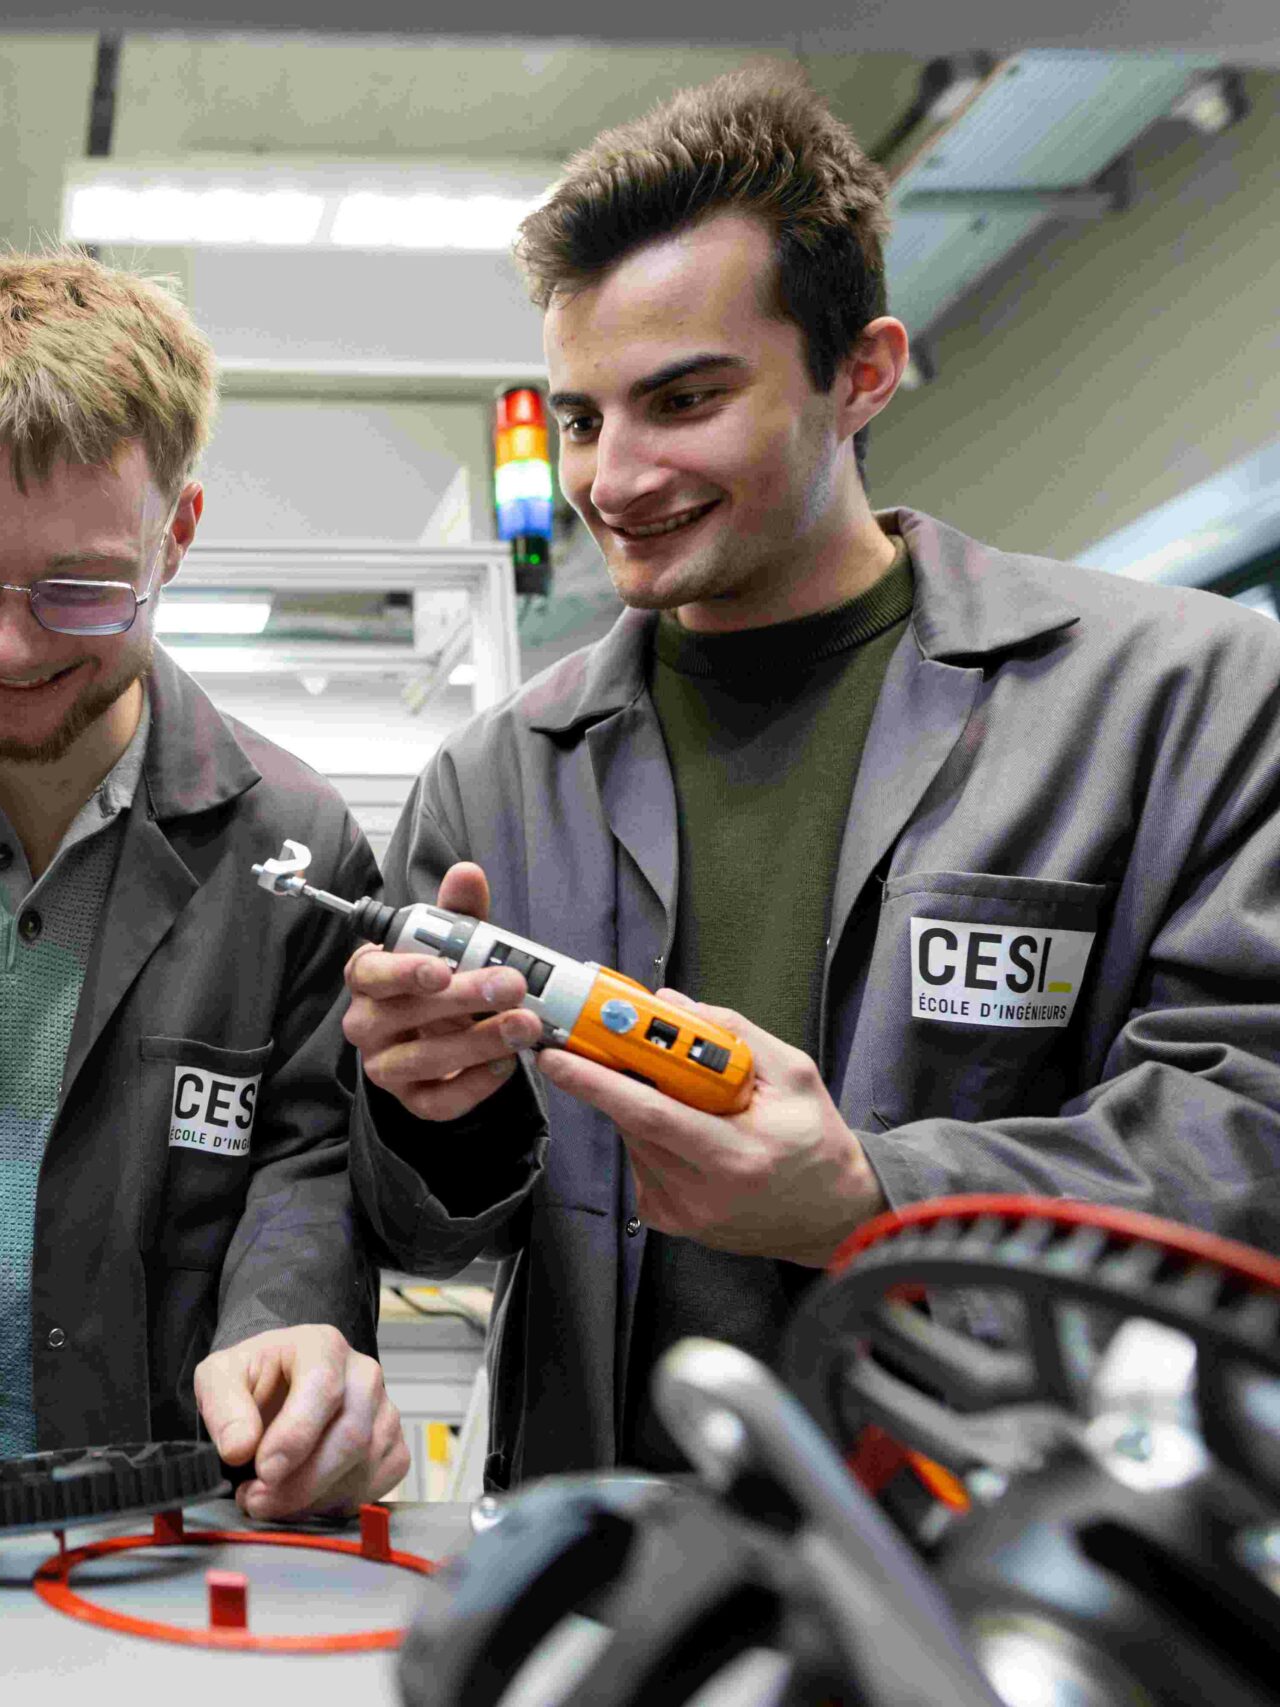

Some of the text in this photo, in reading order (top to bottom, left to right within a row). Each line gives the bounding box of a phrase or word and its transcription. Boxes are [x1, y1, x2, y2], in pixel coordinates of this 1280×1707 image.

[919, 928, 1053, 993] CESI
[919, 993, 1067, 1020] ÉCOLE D'INGÉNIEURS
